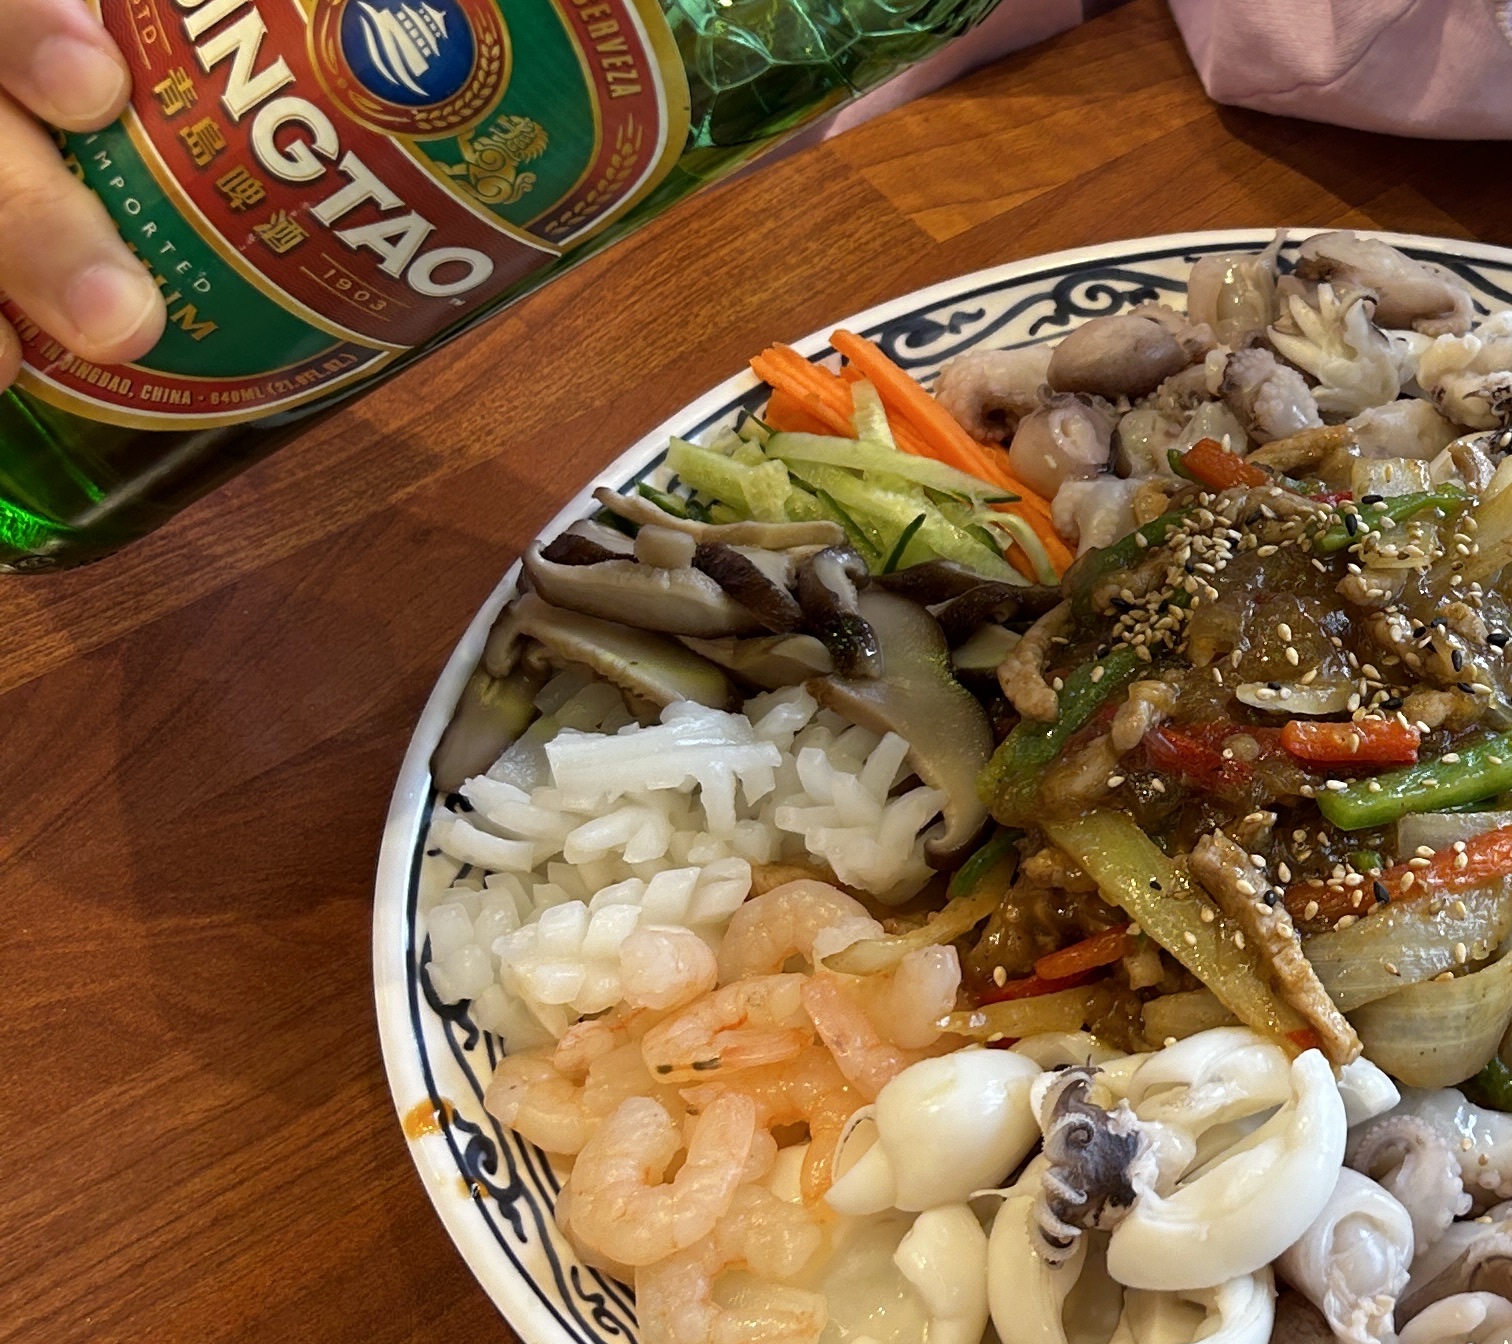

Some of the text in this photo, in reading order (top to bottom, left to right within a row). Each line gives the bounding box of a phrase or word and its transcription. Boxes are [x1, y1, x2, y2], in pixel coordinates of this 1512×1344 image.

[153, 65, 310, 254] 青島啤酒
[322, 267, 388, 312] 1903
[139, 381, 193, 407] CHINA
[210, 385, 266, 406] 640ML
